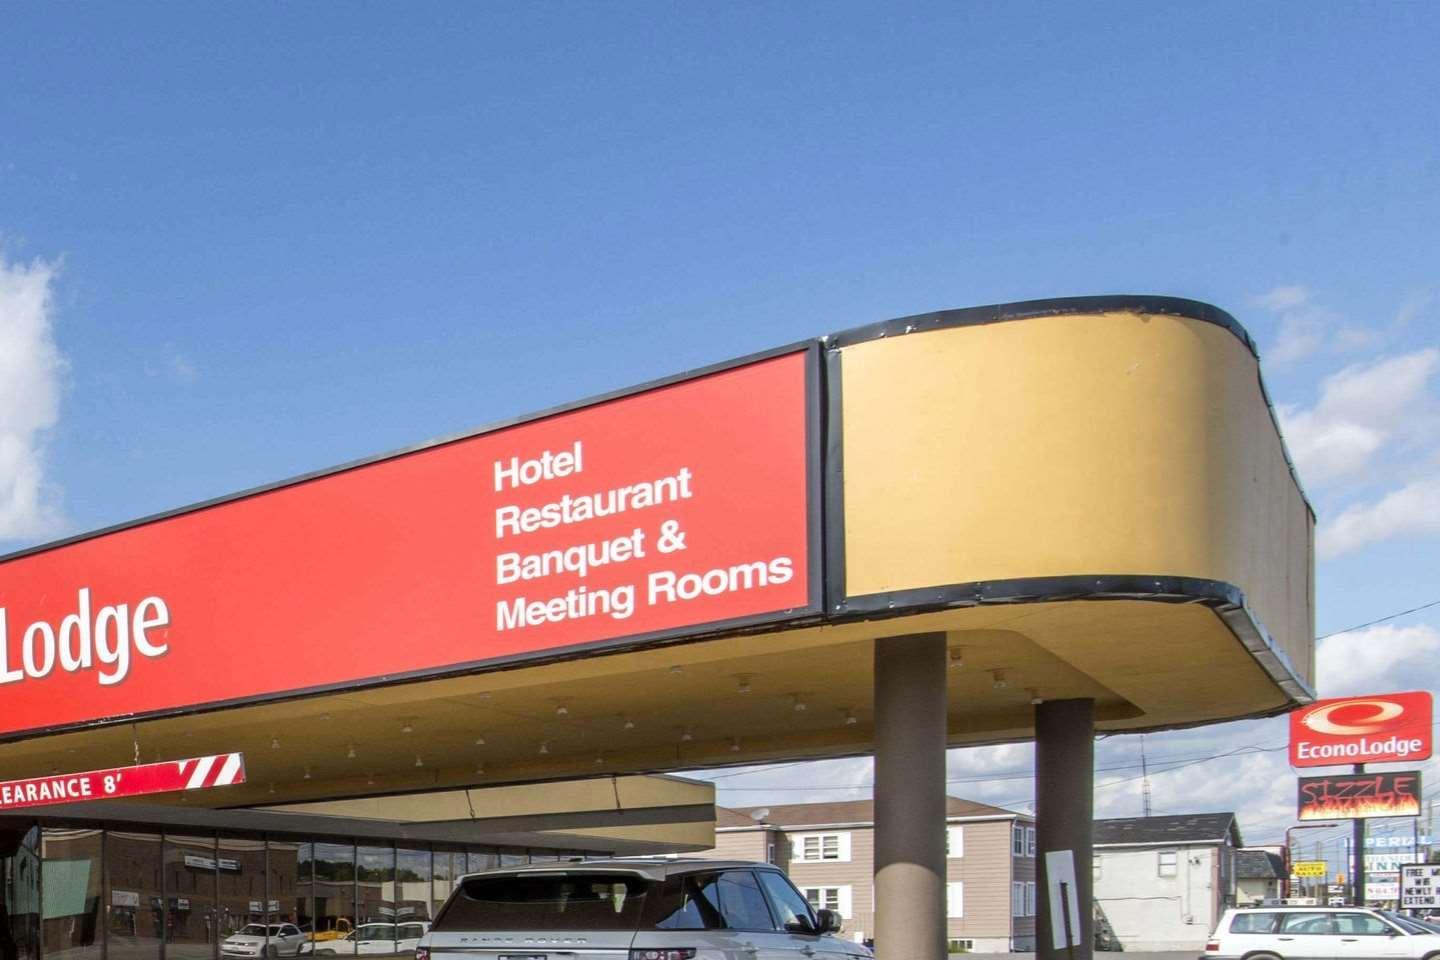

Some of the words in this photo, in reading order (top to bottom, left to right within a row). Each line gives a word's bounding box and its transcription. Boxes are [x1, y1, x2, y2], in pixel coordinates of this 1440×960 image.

[493, 441, 583, 492] Hotel
[495, 467, 693, 539] Restaurant
[496, 527, 646, 585] Banquet
[656, 519, 688, 554] &
[496, 583, 635, 632] Meeting
[647, 556, 794, 606] Rooms
[1297, 737, 1422, 757] EconoLodge
[103, 773, 123, 795] 8'
[1301, 776, 1417, 804] SIZZLE
[523, 936, 588, 944] ROVER
